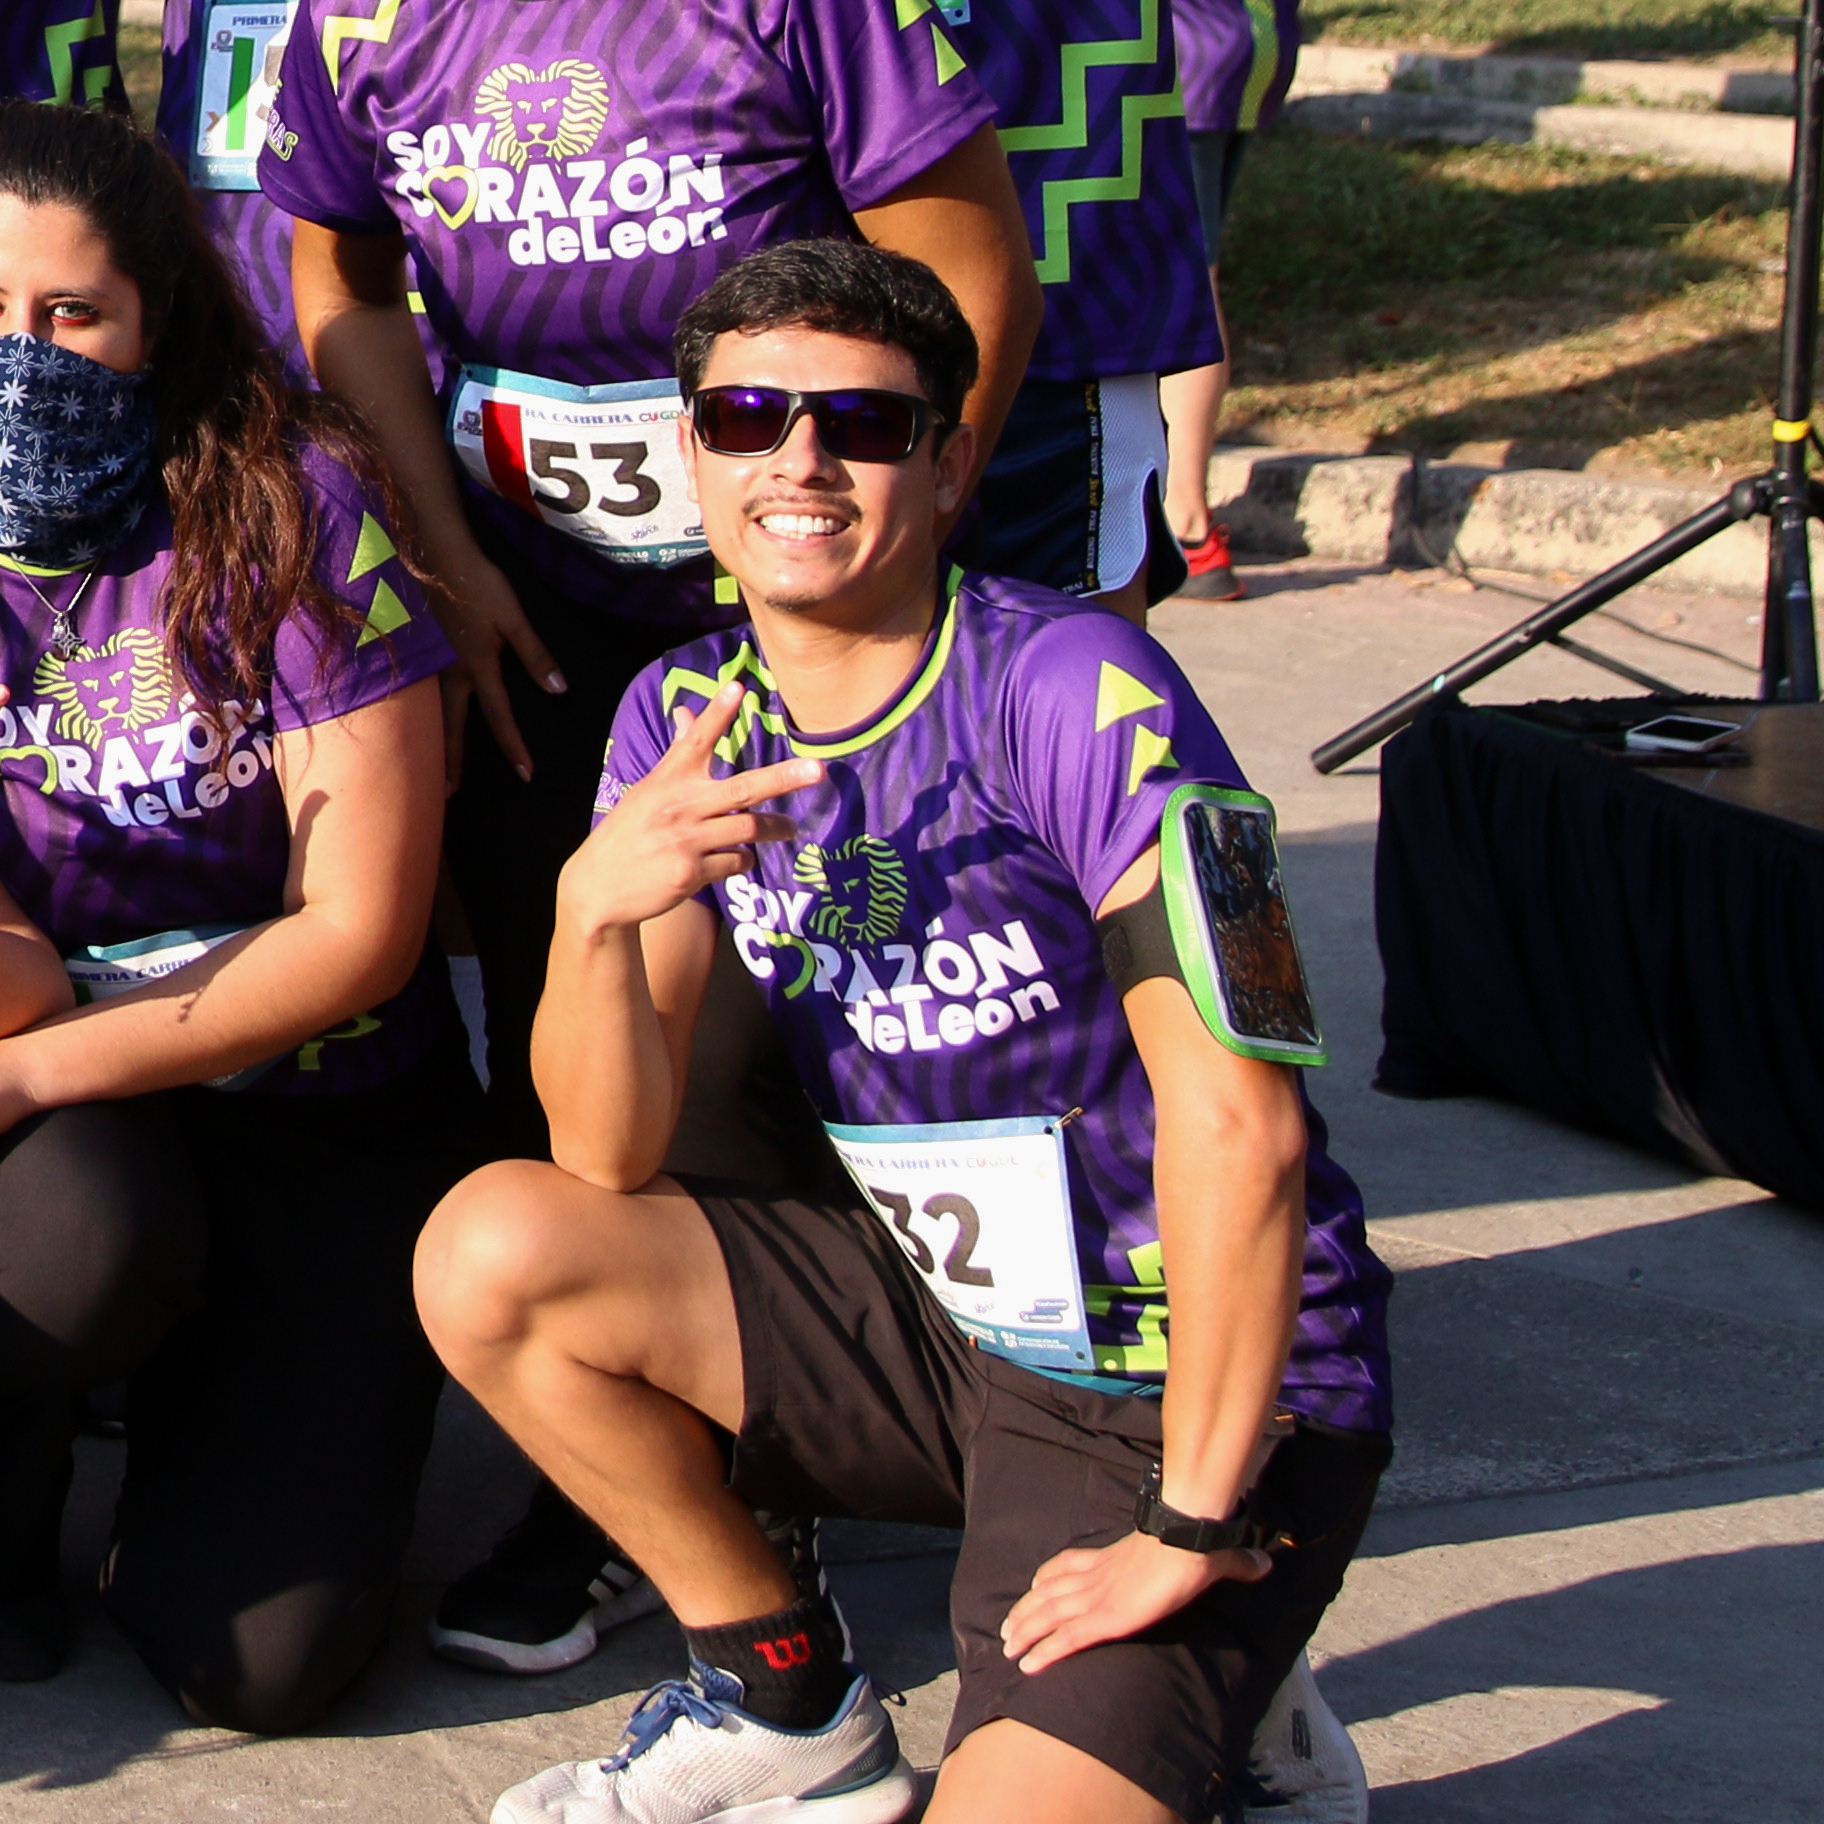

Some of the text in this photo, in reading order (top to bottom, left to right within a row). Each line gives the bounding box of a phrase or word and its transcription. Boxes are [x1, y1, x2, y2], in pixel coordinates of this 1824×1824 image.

[386, 122, 494, 174] SOY
[553, 413, 634, 424] CARRERA
[529, 437, 661, 518] 53
[725, 873, 814, 938] SOY
[866, 1183, 995, 1289] 32
